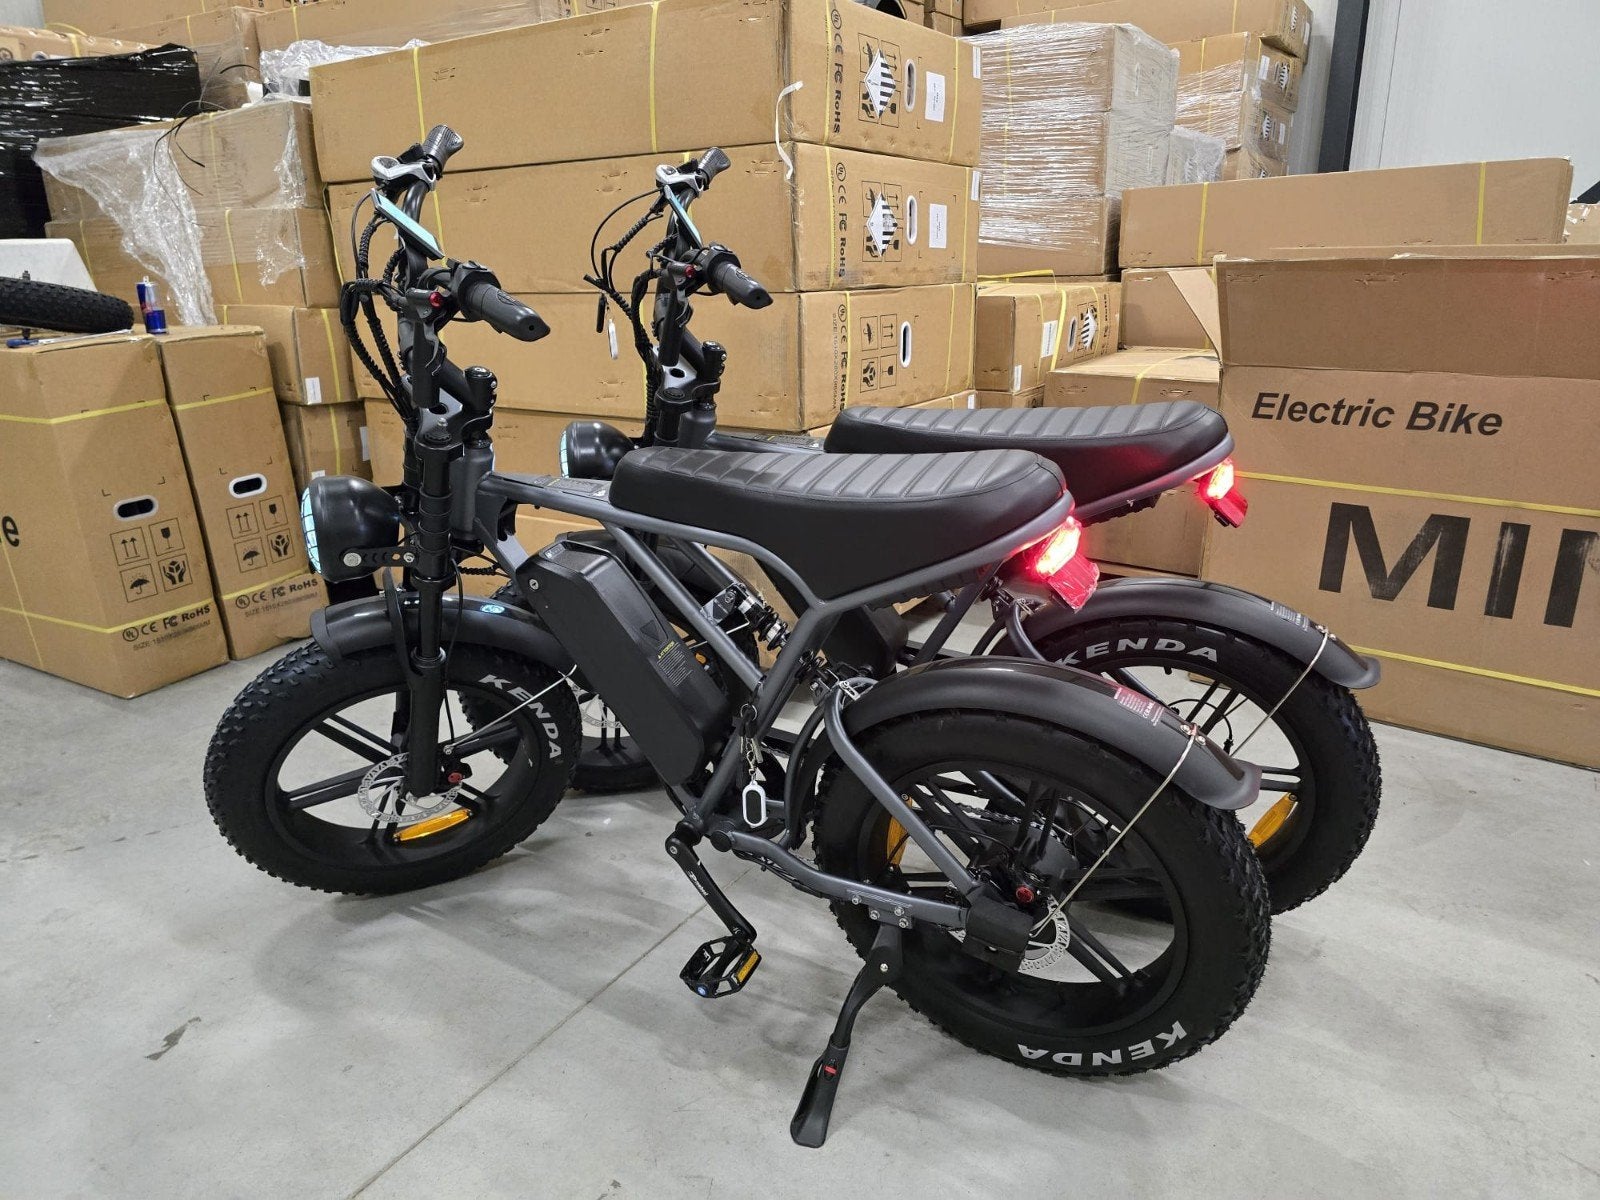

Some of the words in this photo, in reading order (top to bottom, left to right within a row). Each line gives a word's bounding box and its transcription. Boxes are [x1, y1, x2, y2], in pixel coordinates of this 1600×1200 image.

[834, 90, 842, 134] RoHS
[838, 184, 846, 204] CE
[838, 238, 847, 278] RoHS
[1251, 392, 1395, 429] Electric
[1405, 401, 1503, 436] Bike
[252, 590, 267, 604] CE
[290, 578, 319, 594] RoHS
[141, 622, 158, 636] CE
[181, 604, 211, 622] RoHS
[1054, 637, 1218, 667] KENDA
[478, 674, 562, 759] KENDA
[1017, 1020, 1188, 1066] KENDA
